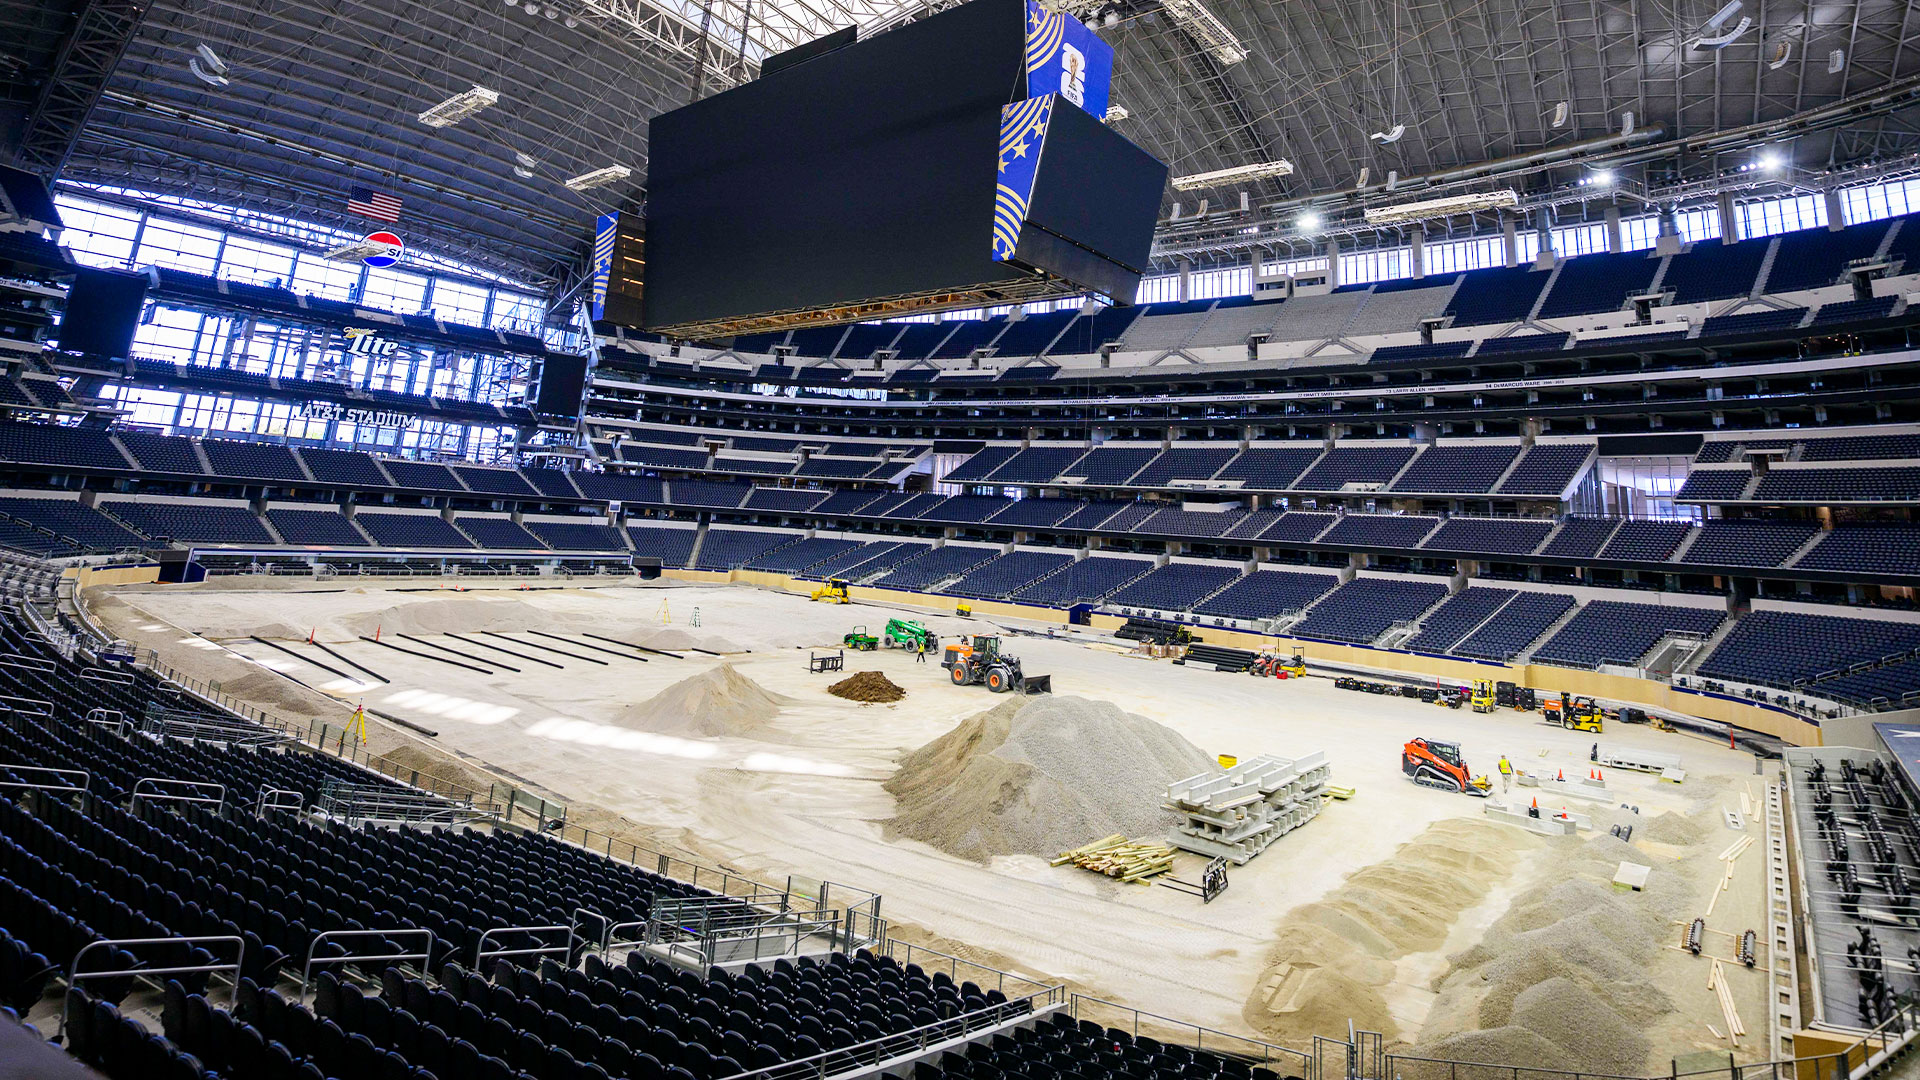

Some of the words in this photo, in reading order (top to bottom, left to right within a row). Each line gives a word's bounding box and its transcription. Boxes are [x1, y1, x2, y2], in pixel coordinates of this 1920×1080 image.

[1067, 90, 1078, 101] FIFA
[347, 333, 399, 356] Lite
[301, 403, 344, 420] AT&T
[346, 408, 416, 428] STADIUM
